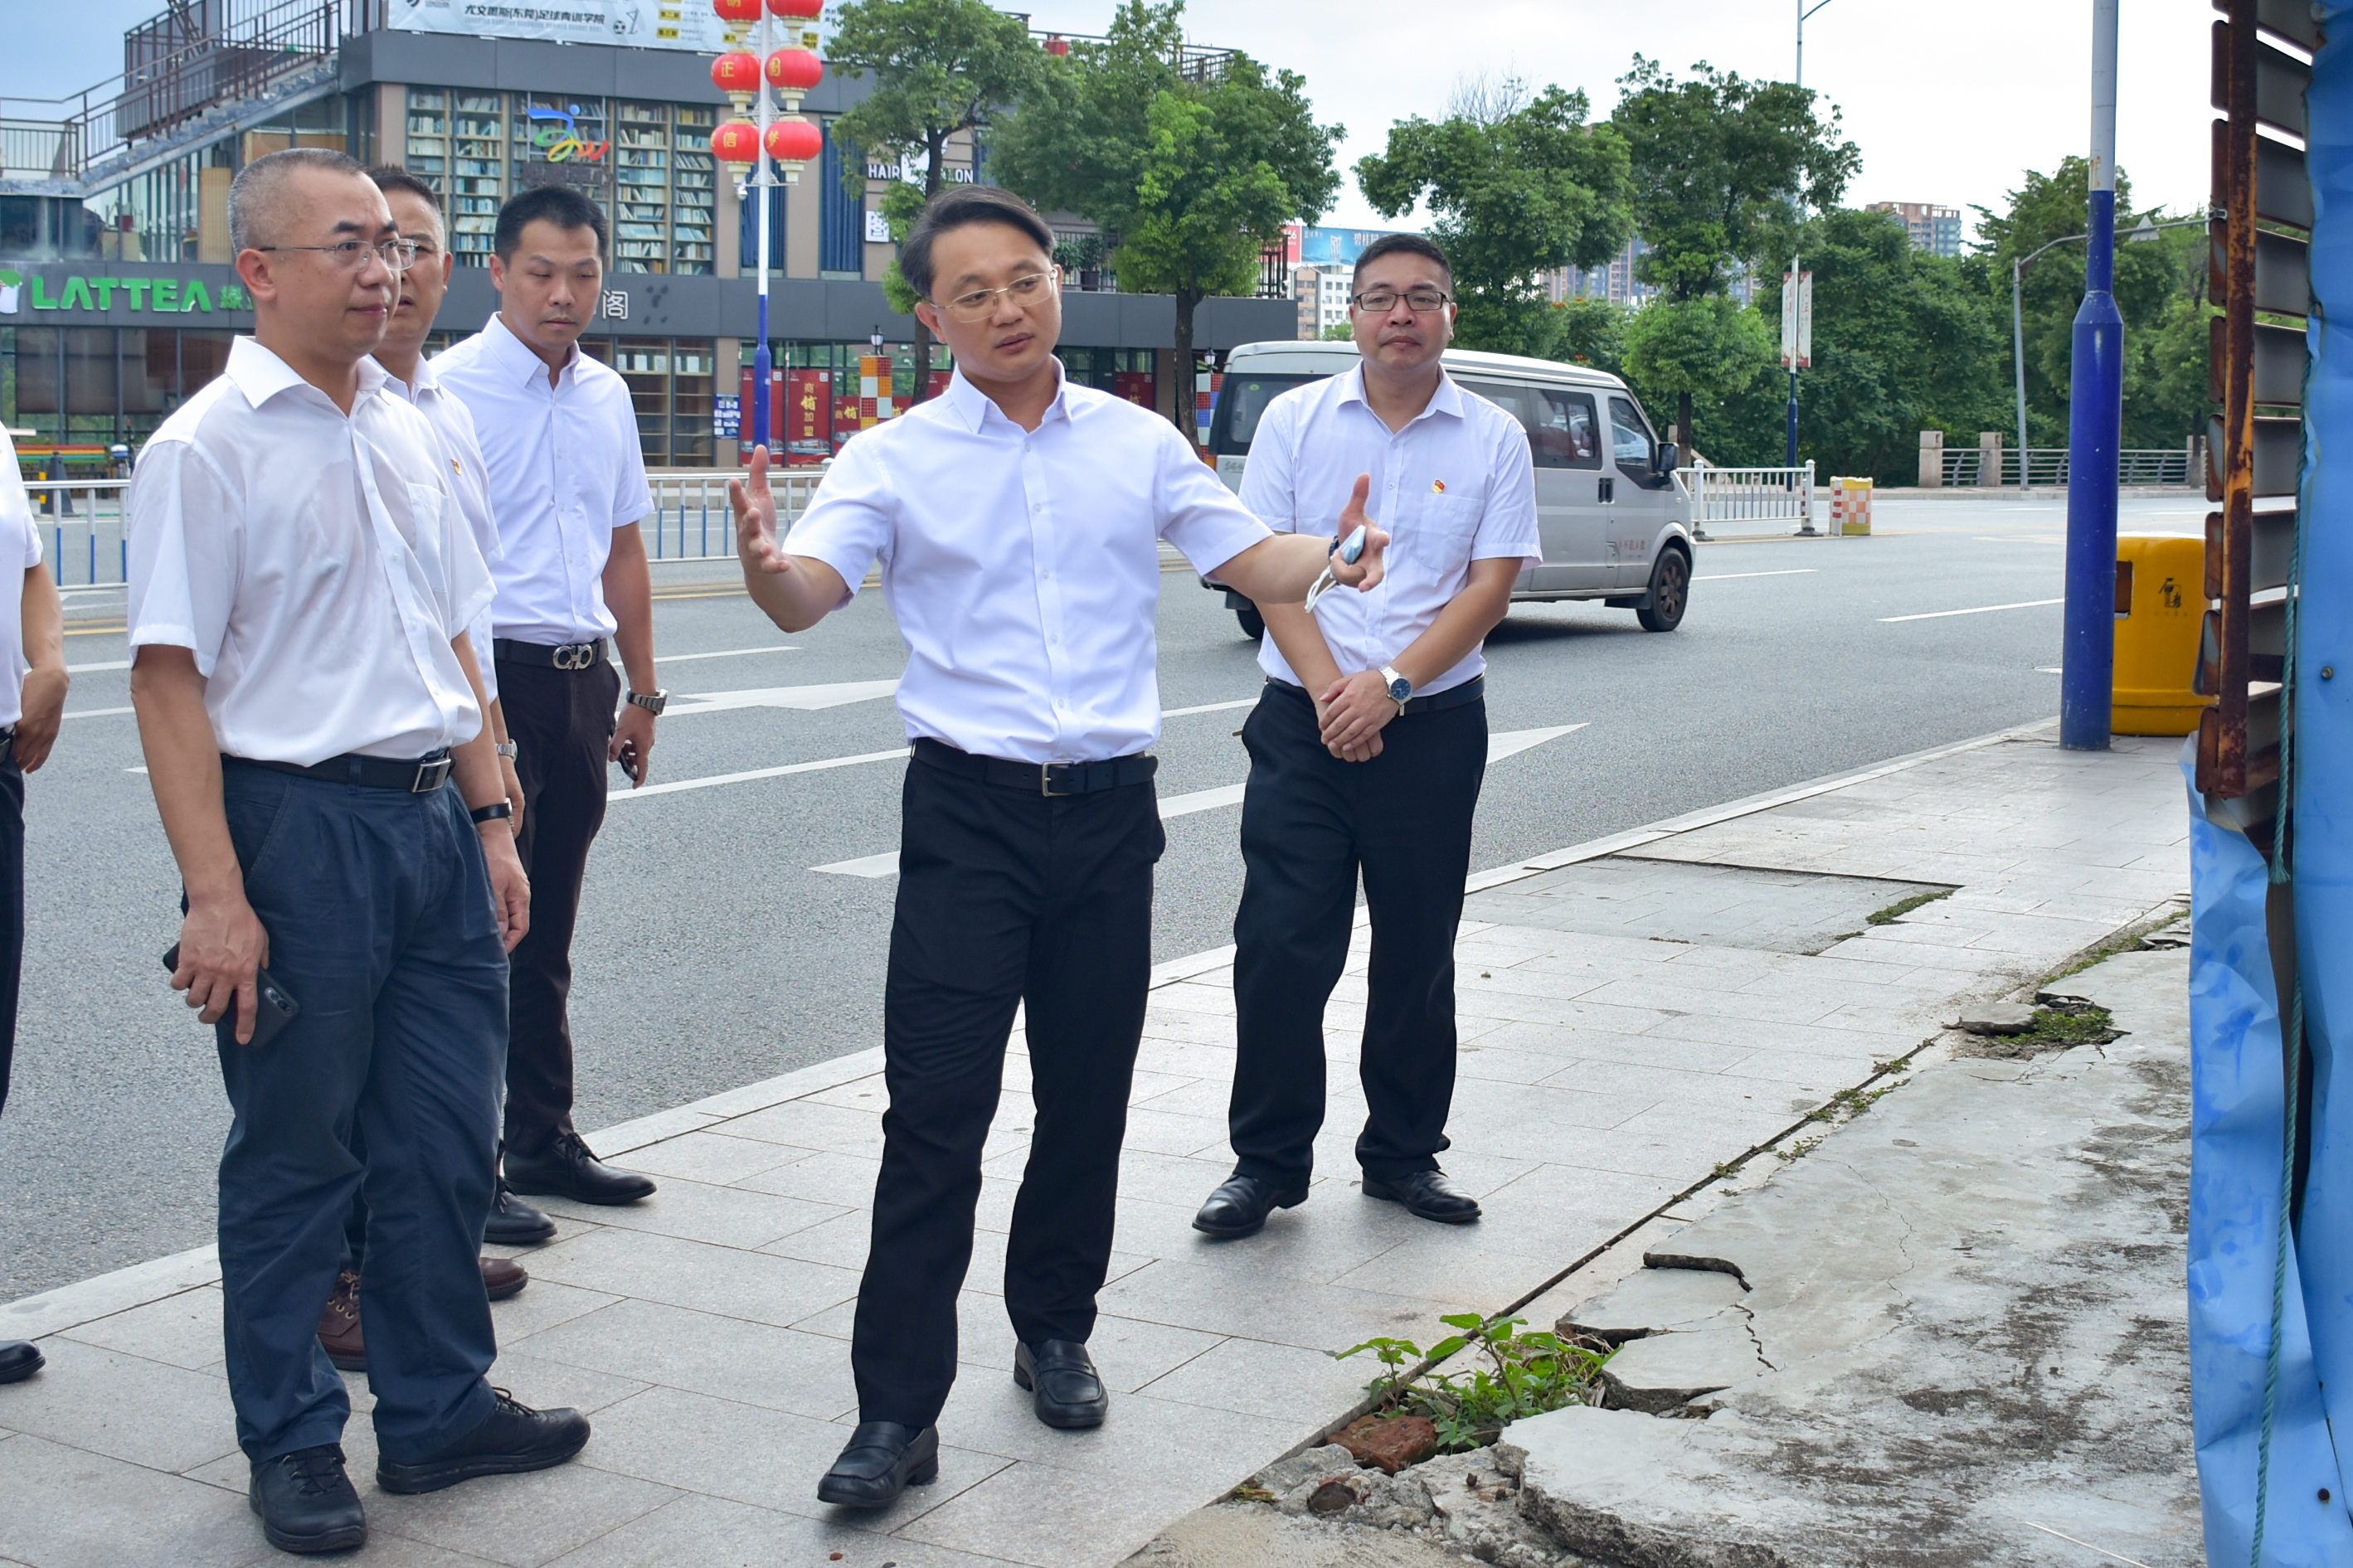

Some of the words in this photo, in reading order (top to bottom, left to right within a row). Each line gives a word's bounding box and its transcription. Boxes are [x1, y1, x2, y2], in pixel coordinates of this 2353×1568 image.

[721, 61, 735, 77] 正
[723, 131, 737, 148] 信
[868, 165, 901, 179] HAIR
[32, 275, 212, 313] LATTEA
[602, 289, 629, 320] 阁
